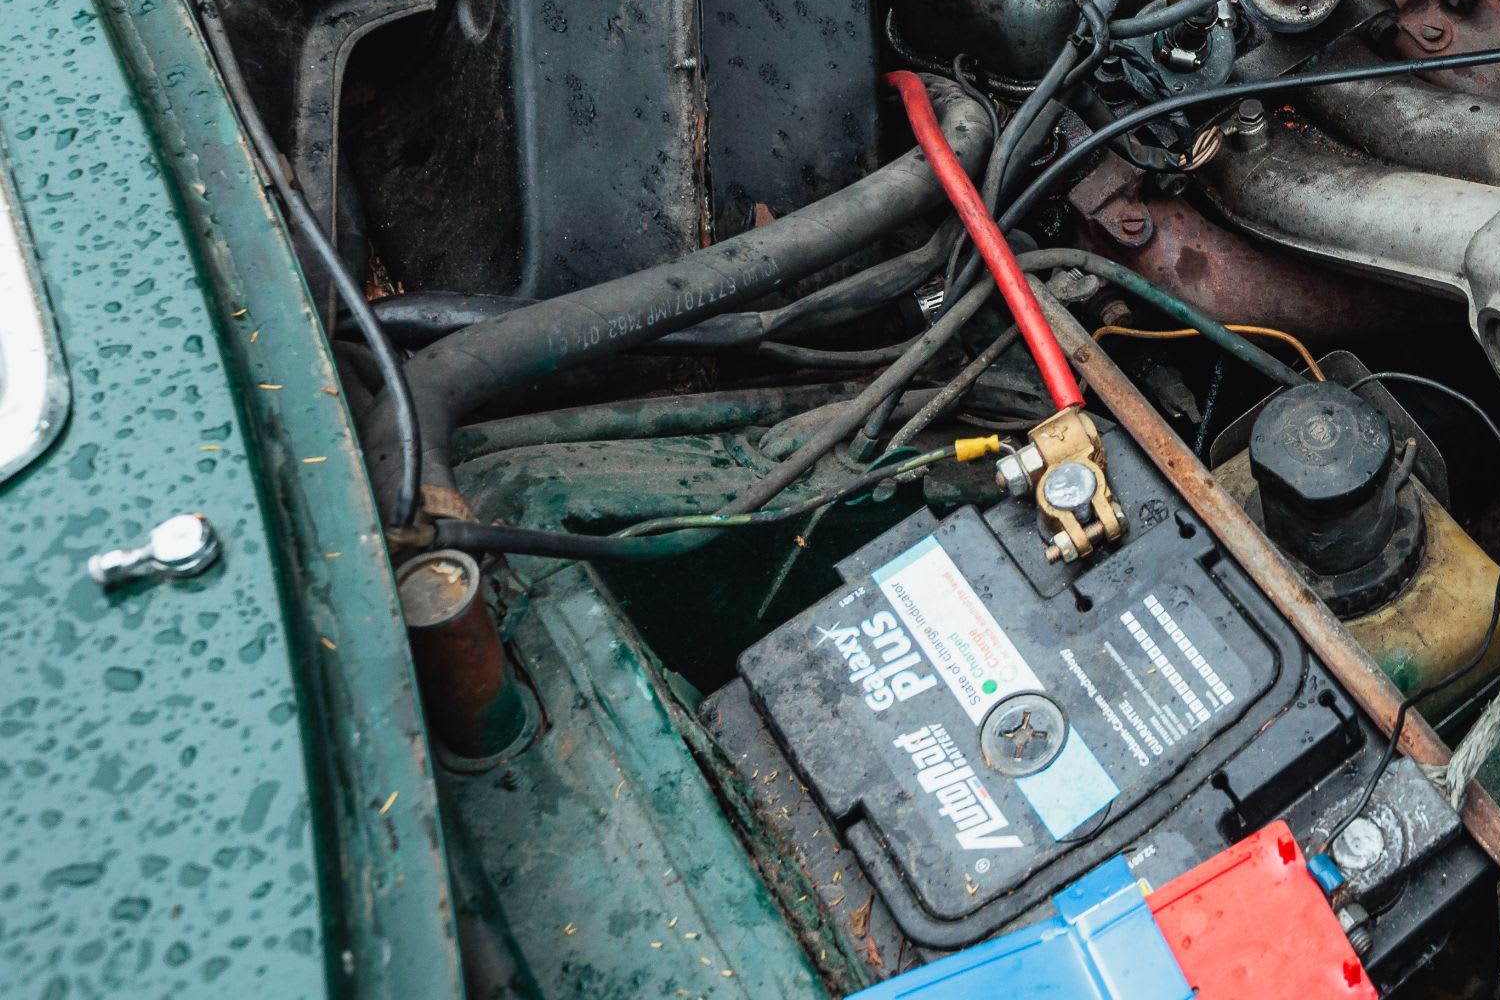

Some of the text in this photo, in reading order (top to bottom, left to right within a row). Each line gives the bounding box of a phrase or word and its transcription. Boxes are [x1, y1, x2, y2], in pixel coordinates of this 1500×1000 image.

[825, 628, 898, 714] Galaxy
[851, 605, 939, 701] Plus
[887, 579, 983, 707] State of charge indicator
[945, 628, 989, 681] Charged
[964, 624, 1003, 670] Charge
[1057, 646, 1151, 767] Calcium-Calcium Technology
[1117, 698, 1165, 756] GUARANTEE
[922, 718, 969, 769] BATTERY
